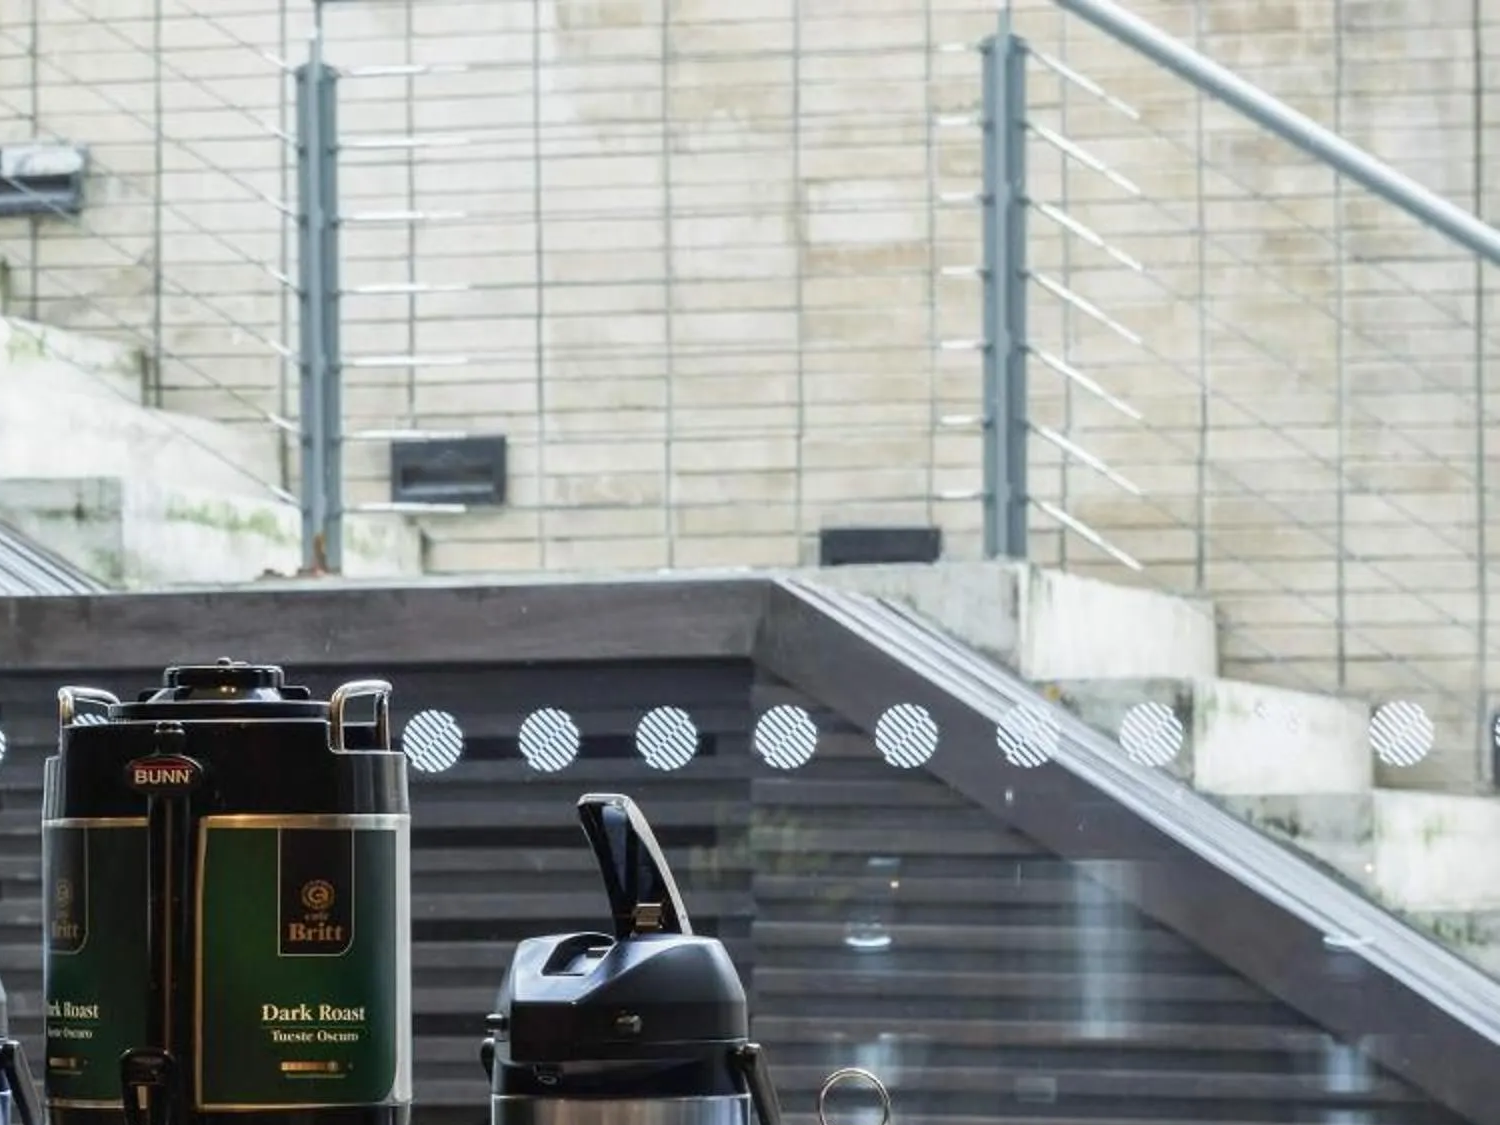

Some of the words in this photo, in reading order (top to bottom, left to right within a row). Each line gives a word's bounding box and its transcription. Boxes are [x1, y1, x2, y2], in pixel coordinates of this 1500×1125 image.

[134, 768, 190, 785] BUNN
[288, 922, 343, 941] Britt
[63, 1001, 99, 1019] Roast
[261, 1003, 314, 1022] Dark
[318, 1003, 366, 1022] Roast
[271, 1029, 315, 1042] Tueste
[316, 1029, 360, 1042] Oscuro
